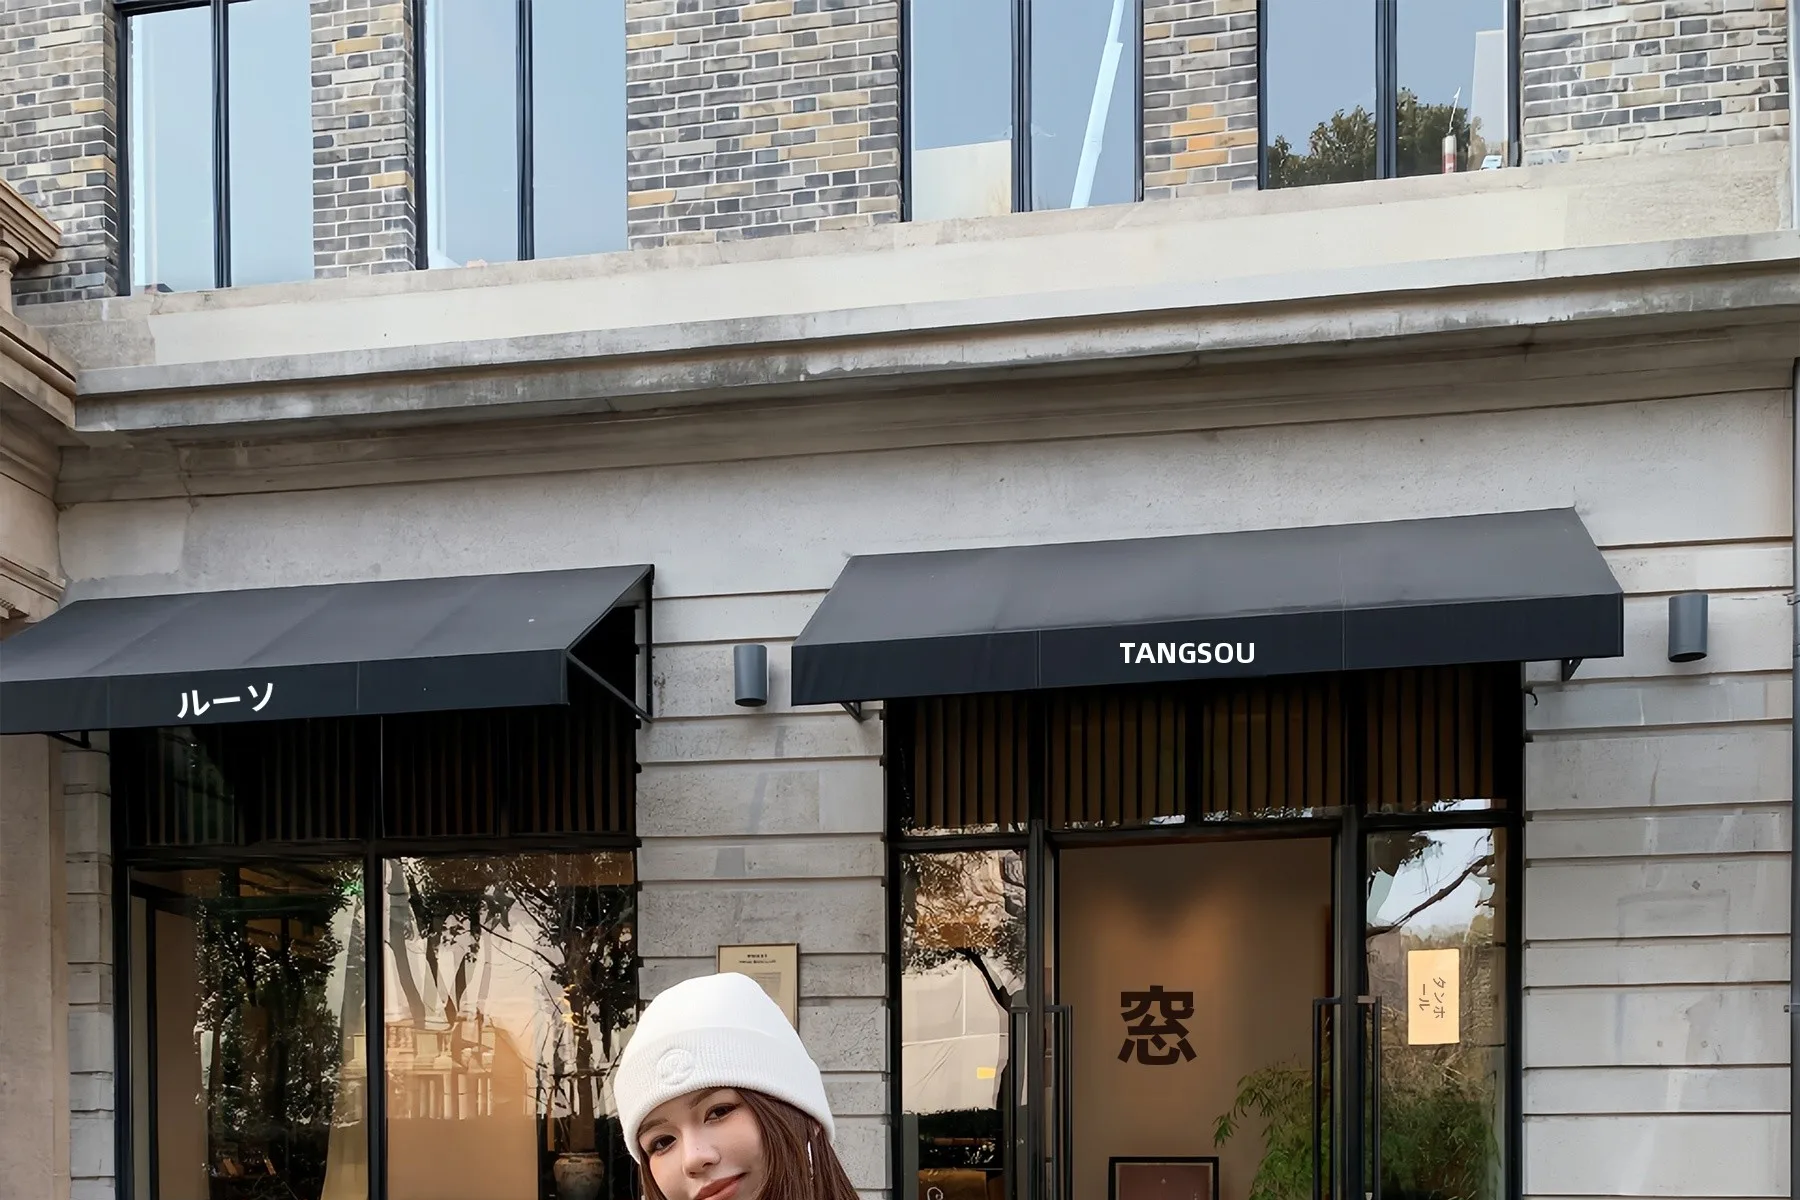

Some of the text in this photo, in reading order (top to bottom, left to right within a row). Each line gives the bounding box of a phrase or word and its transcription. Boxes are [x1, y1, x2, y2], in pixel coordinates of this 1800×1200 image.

[1119, 642, 1255, 664] TANGSOU
[177, 682, 273, 719] ルーソ
